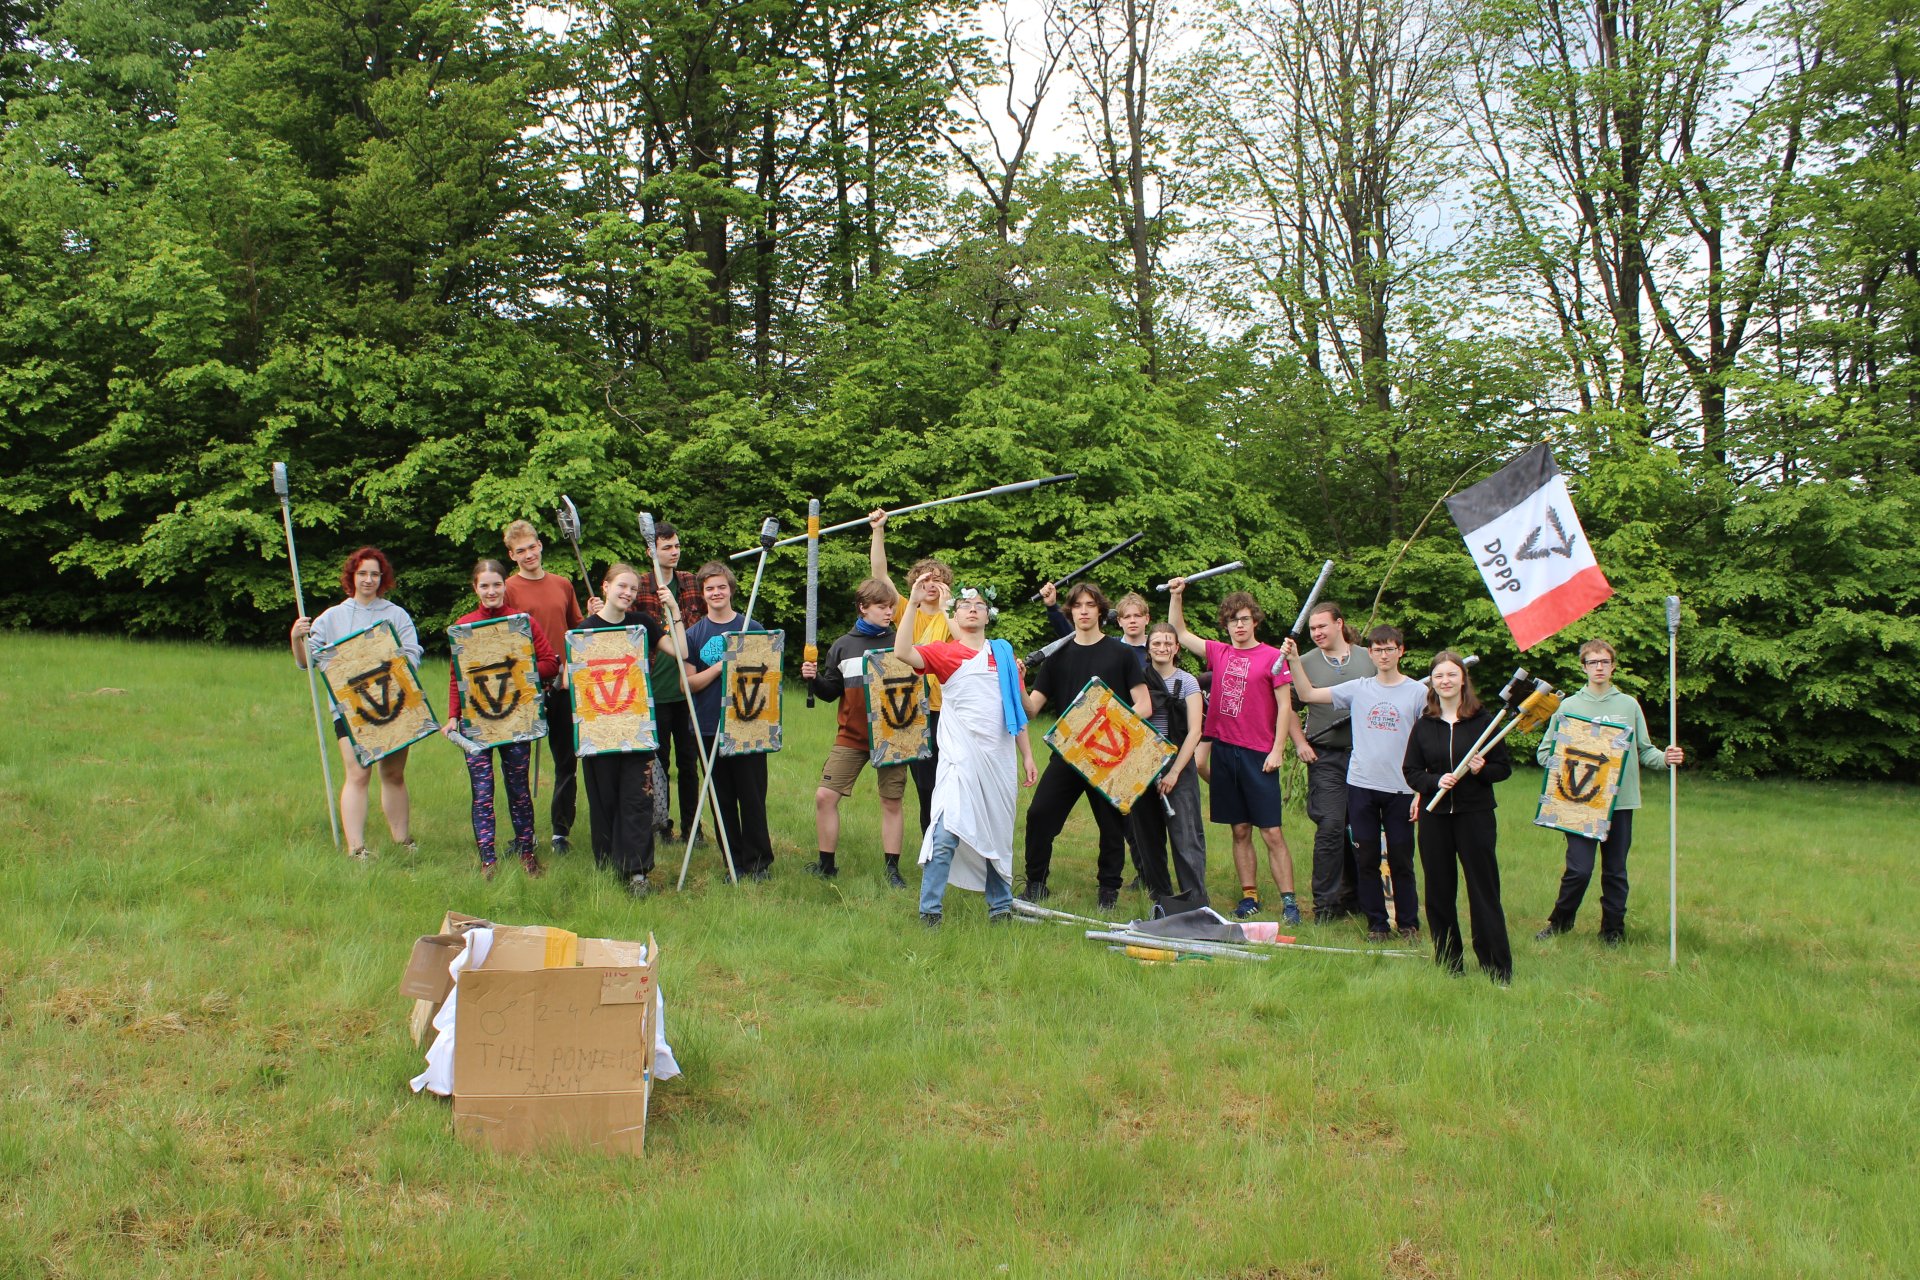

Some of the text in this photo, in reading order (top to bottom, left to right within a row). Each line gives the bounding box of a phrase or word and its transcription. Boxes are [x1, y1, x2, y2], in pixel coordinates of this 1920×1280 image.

[355, 674, 391, 717] V
[474, 671, 512, 713] V
[591, 667, 629, 708] V
[737, 676, 763, 715] V
[885, 687, 914, 723] V
[1085, 718, 1124, 757] V
[1565, 759, 1600, 796] V
[473, 1041, 535, 1073] THE
[523, 1071, 591, 1095] ARMY
